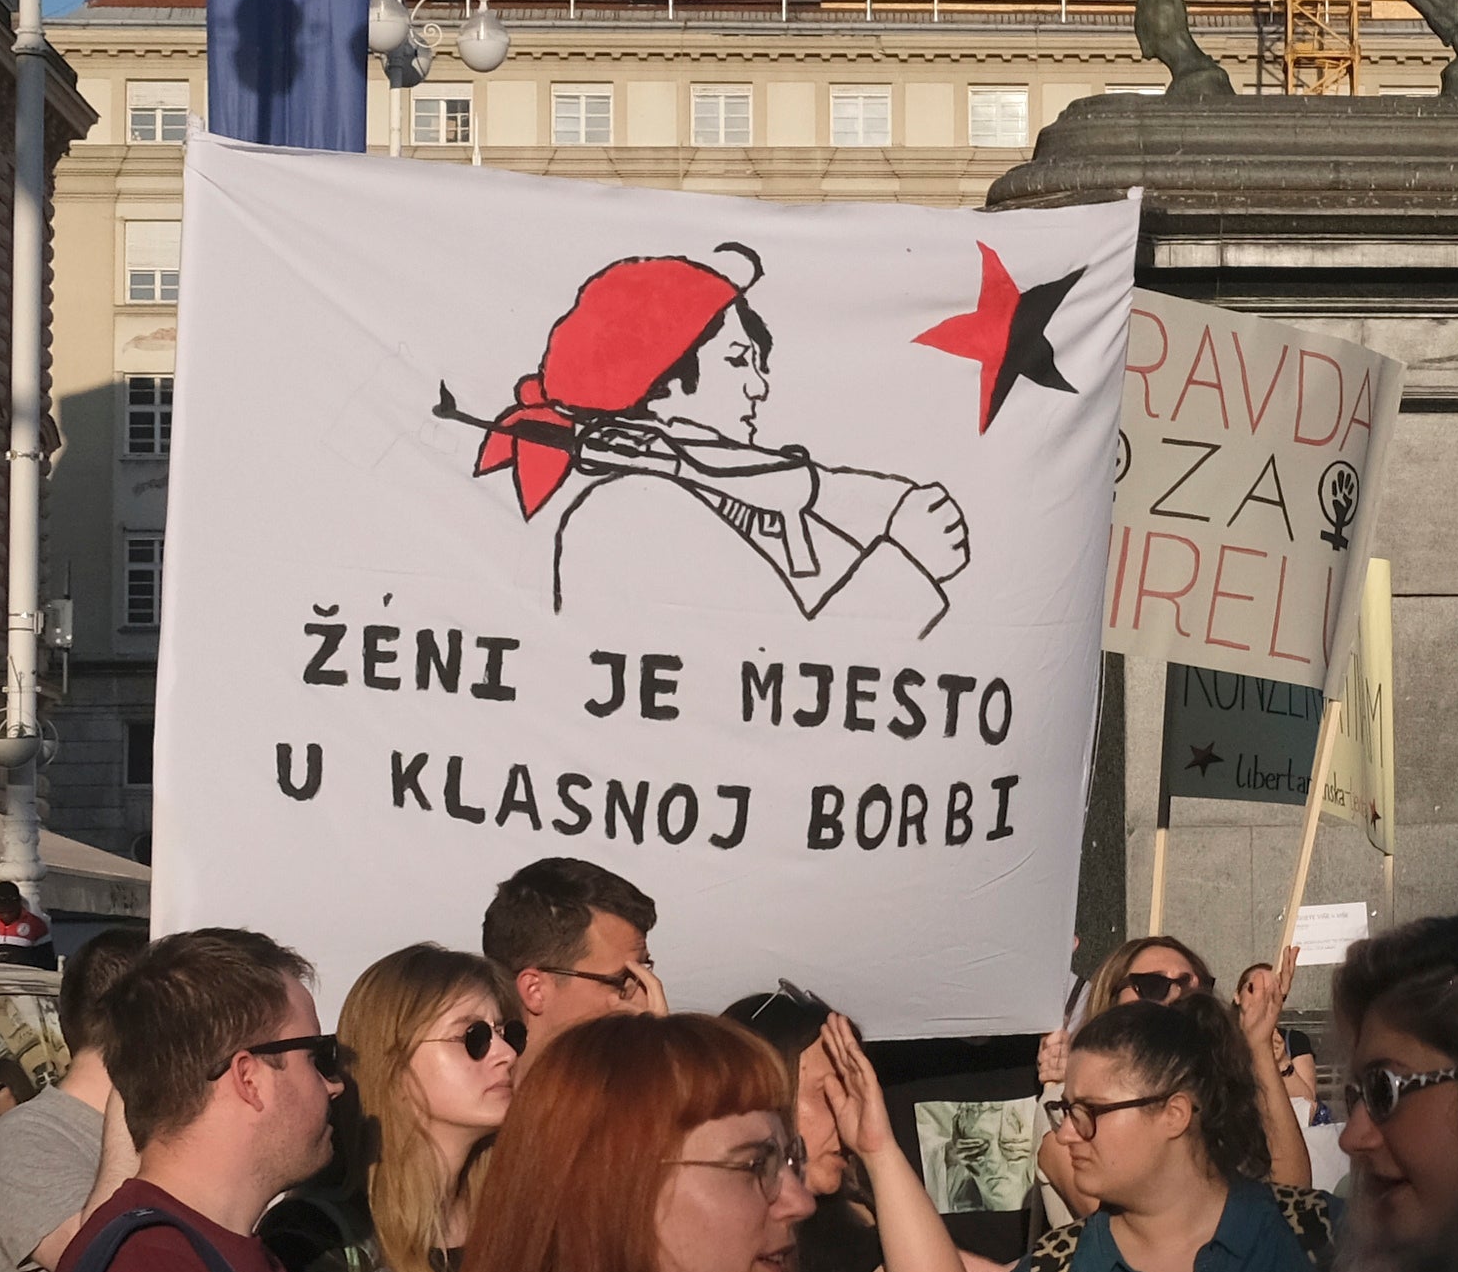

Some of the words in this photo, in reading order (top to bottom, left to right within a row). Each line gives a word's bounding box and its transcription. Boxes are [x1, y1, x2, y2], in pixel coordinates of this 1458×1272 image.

[1125, 307, 1373, 453] RAVDA
[1149, 437, 1294, 543] ZA
[1108, 522, 1333, 669] IREL
[583, 649, 684, 721] JE
[740, 653, 1014, 747] MJESTO
[275, 741, 324, 802] U
[389, 750, 751, 850] KLASNOJ
[806, 774, 1022, 851] BORBI
